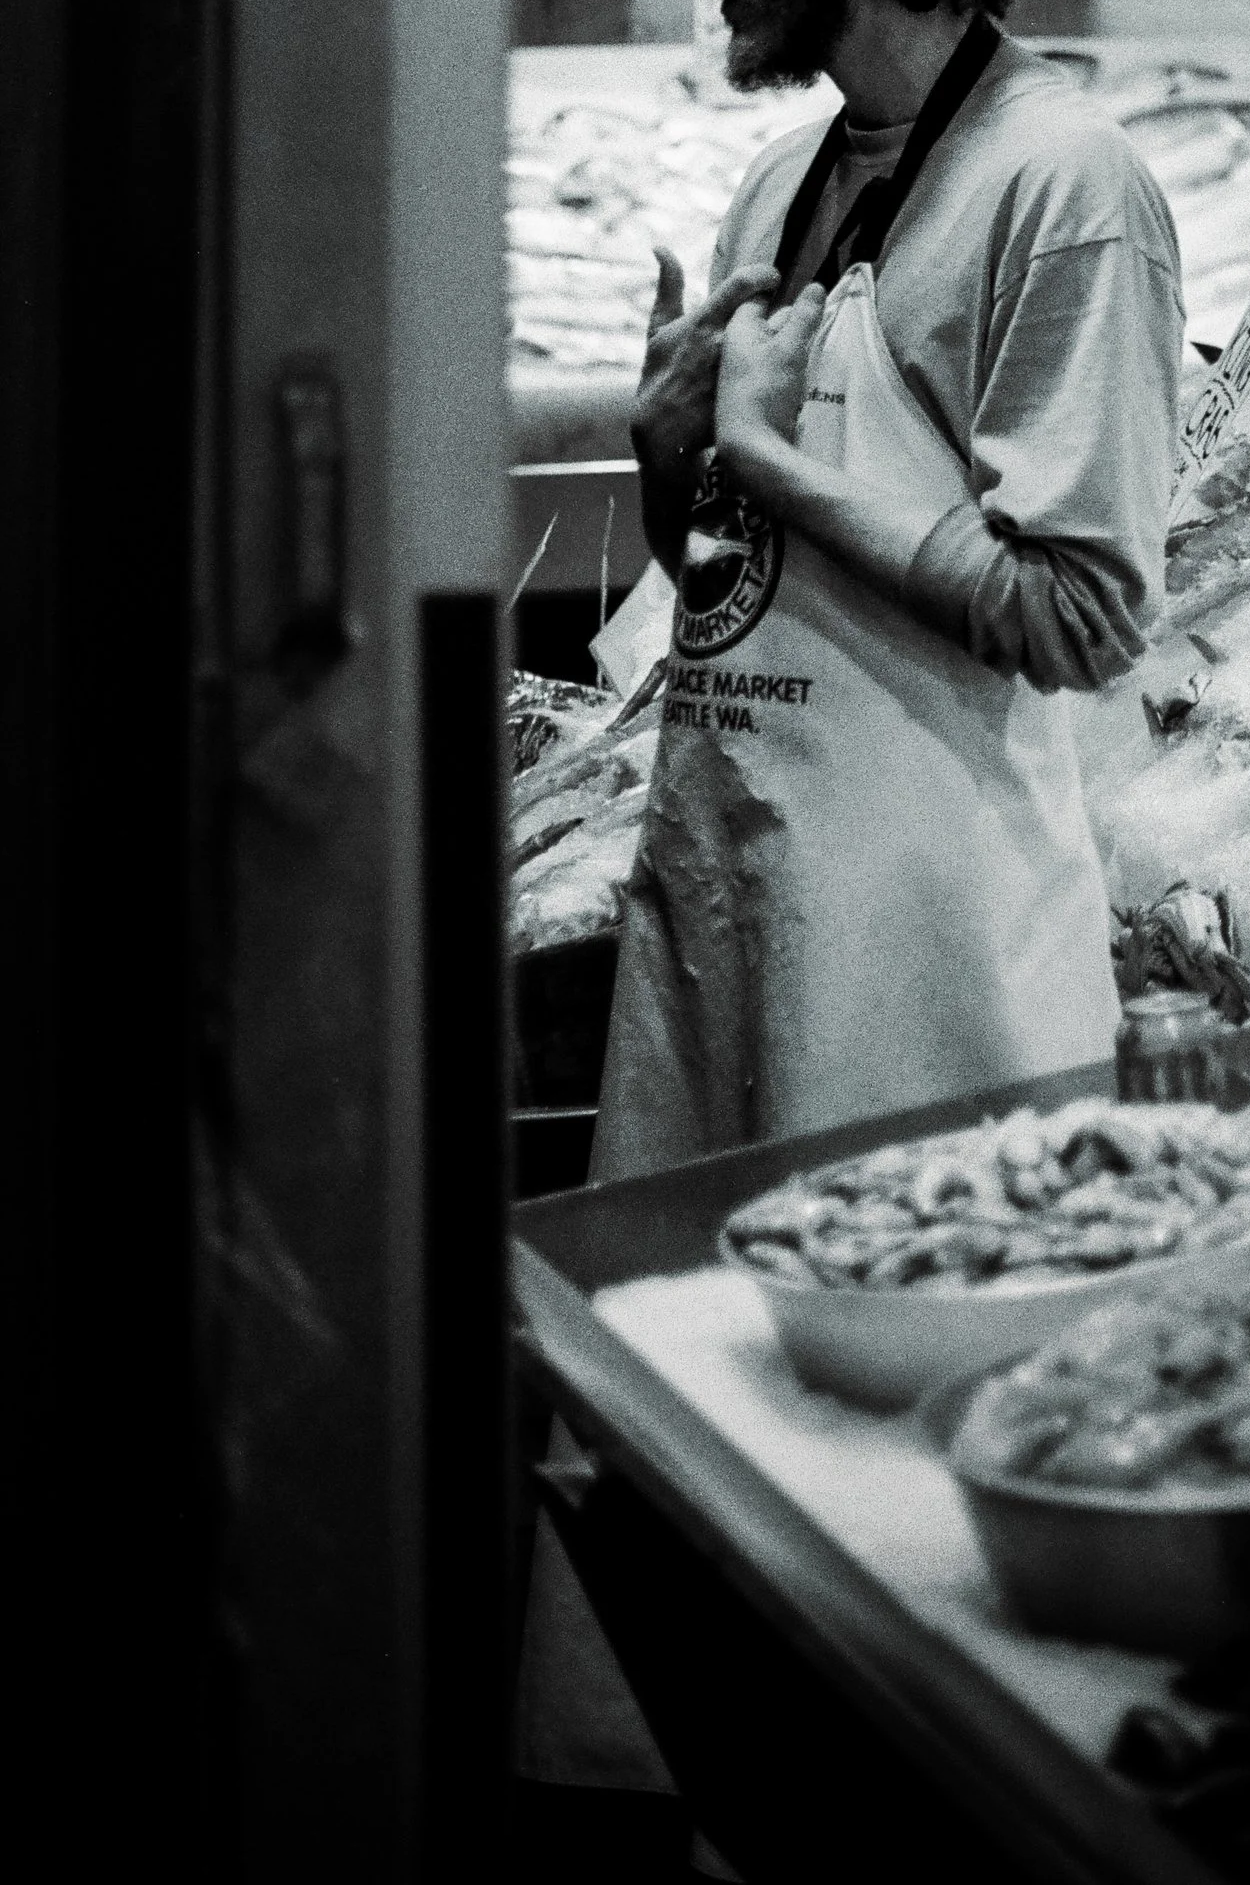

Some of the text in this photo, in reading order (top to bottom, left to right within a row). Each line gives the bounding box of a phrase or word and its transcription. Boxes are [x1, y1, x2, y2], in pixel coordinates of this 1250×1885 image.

[1181, 384, 1231, 462] CRAB
[681, 564, 766, 647] MARKET
[713, 671, 815, 706] MARKET
[714, 703, 761, 735] WA.
